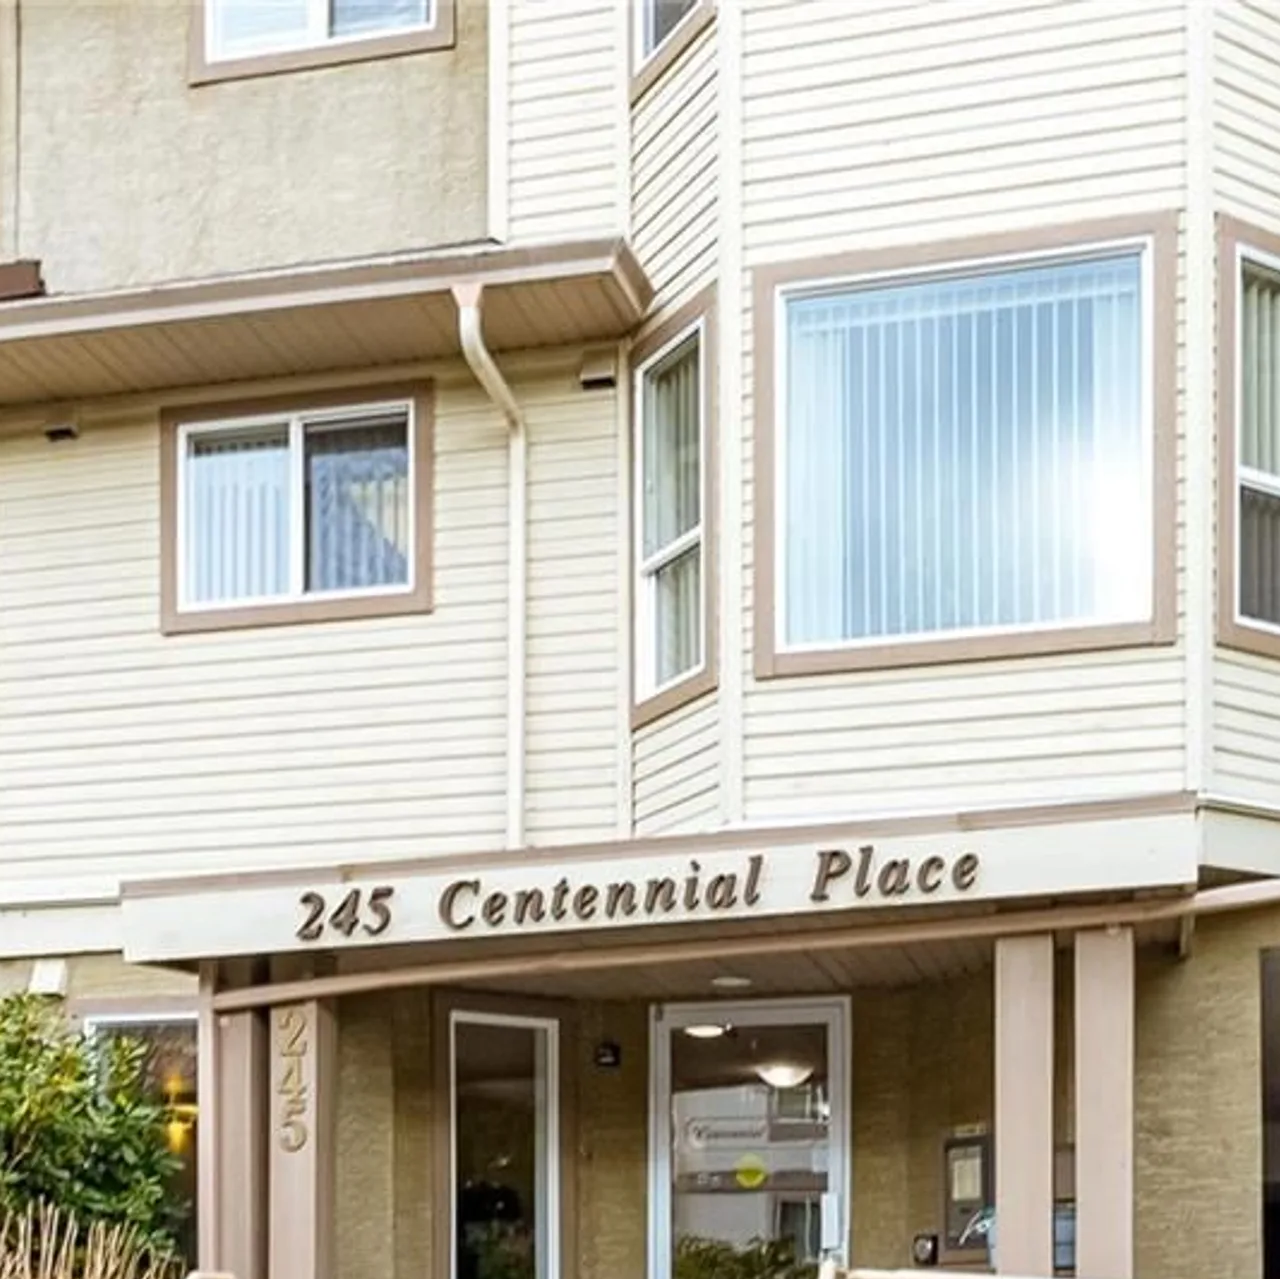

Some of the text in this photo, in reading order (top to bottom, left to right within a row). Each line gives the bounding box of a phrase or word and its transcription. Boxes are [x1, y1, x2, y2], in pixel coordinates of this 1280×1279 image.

[295, 845, 981, 941] 245 Centennial Place
[275, 1010, 309, 1153] 245
